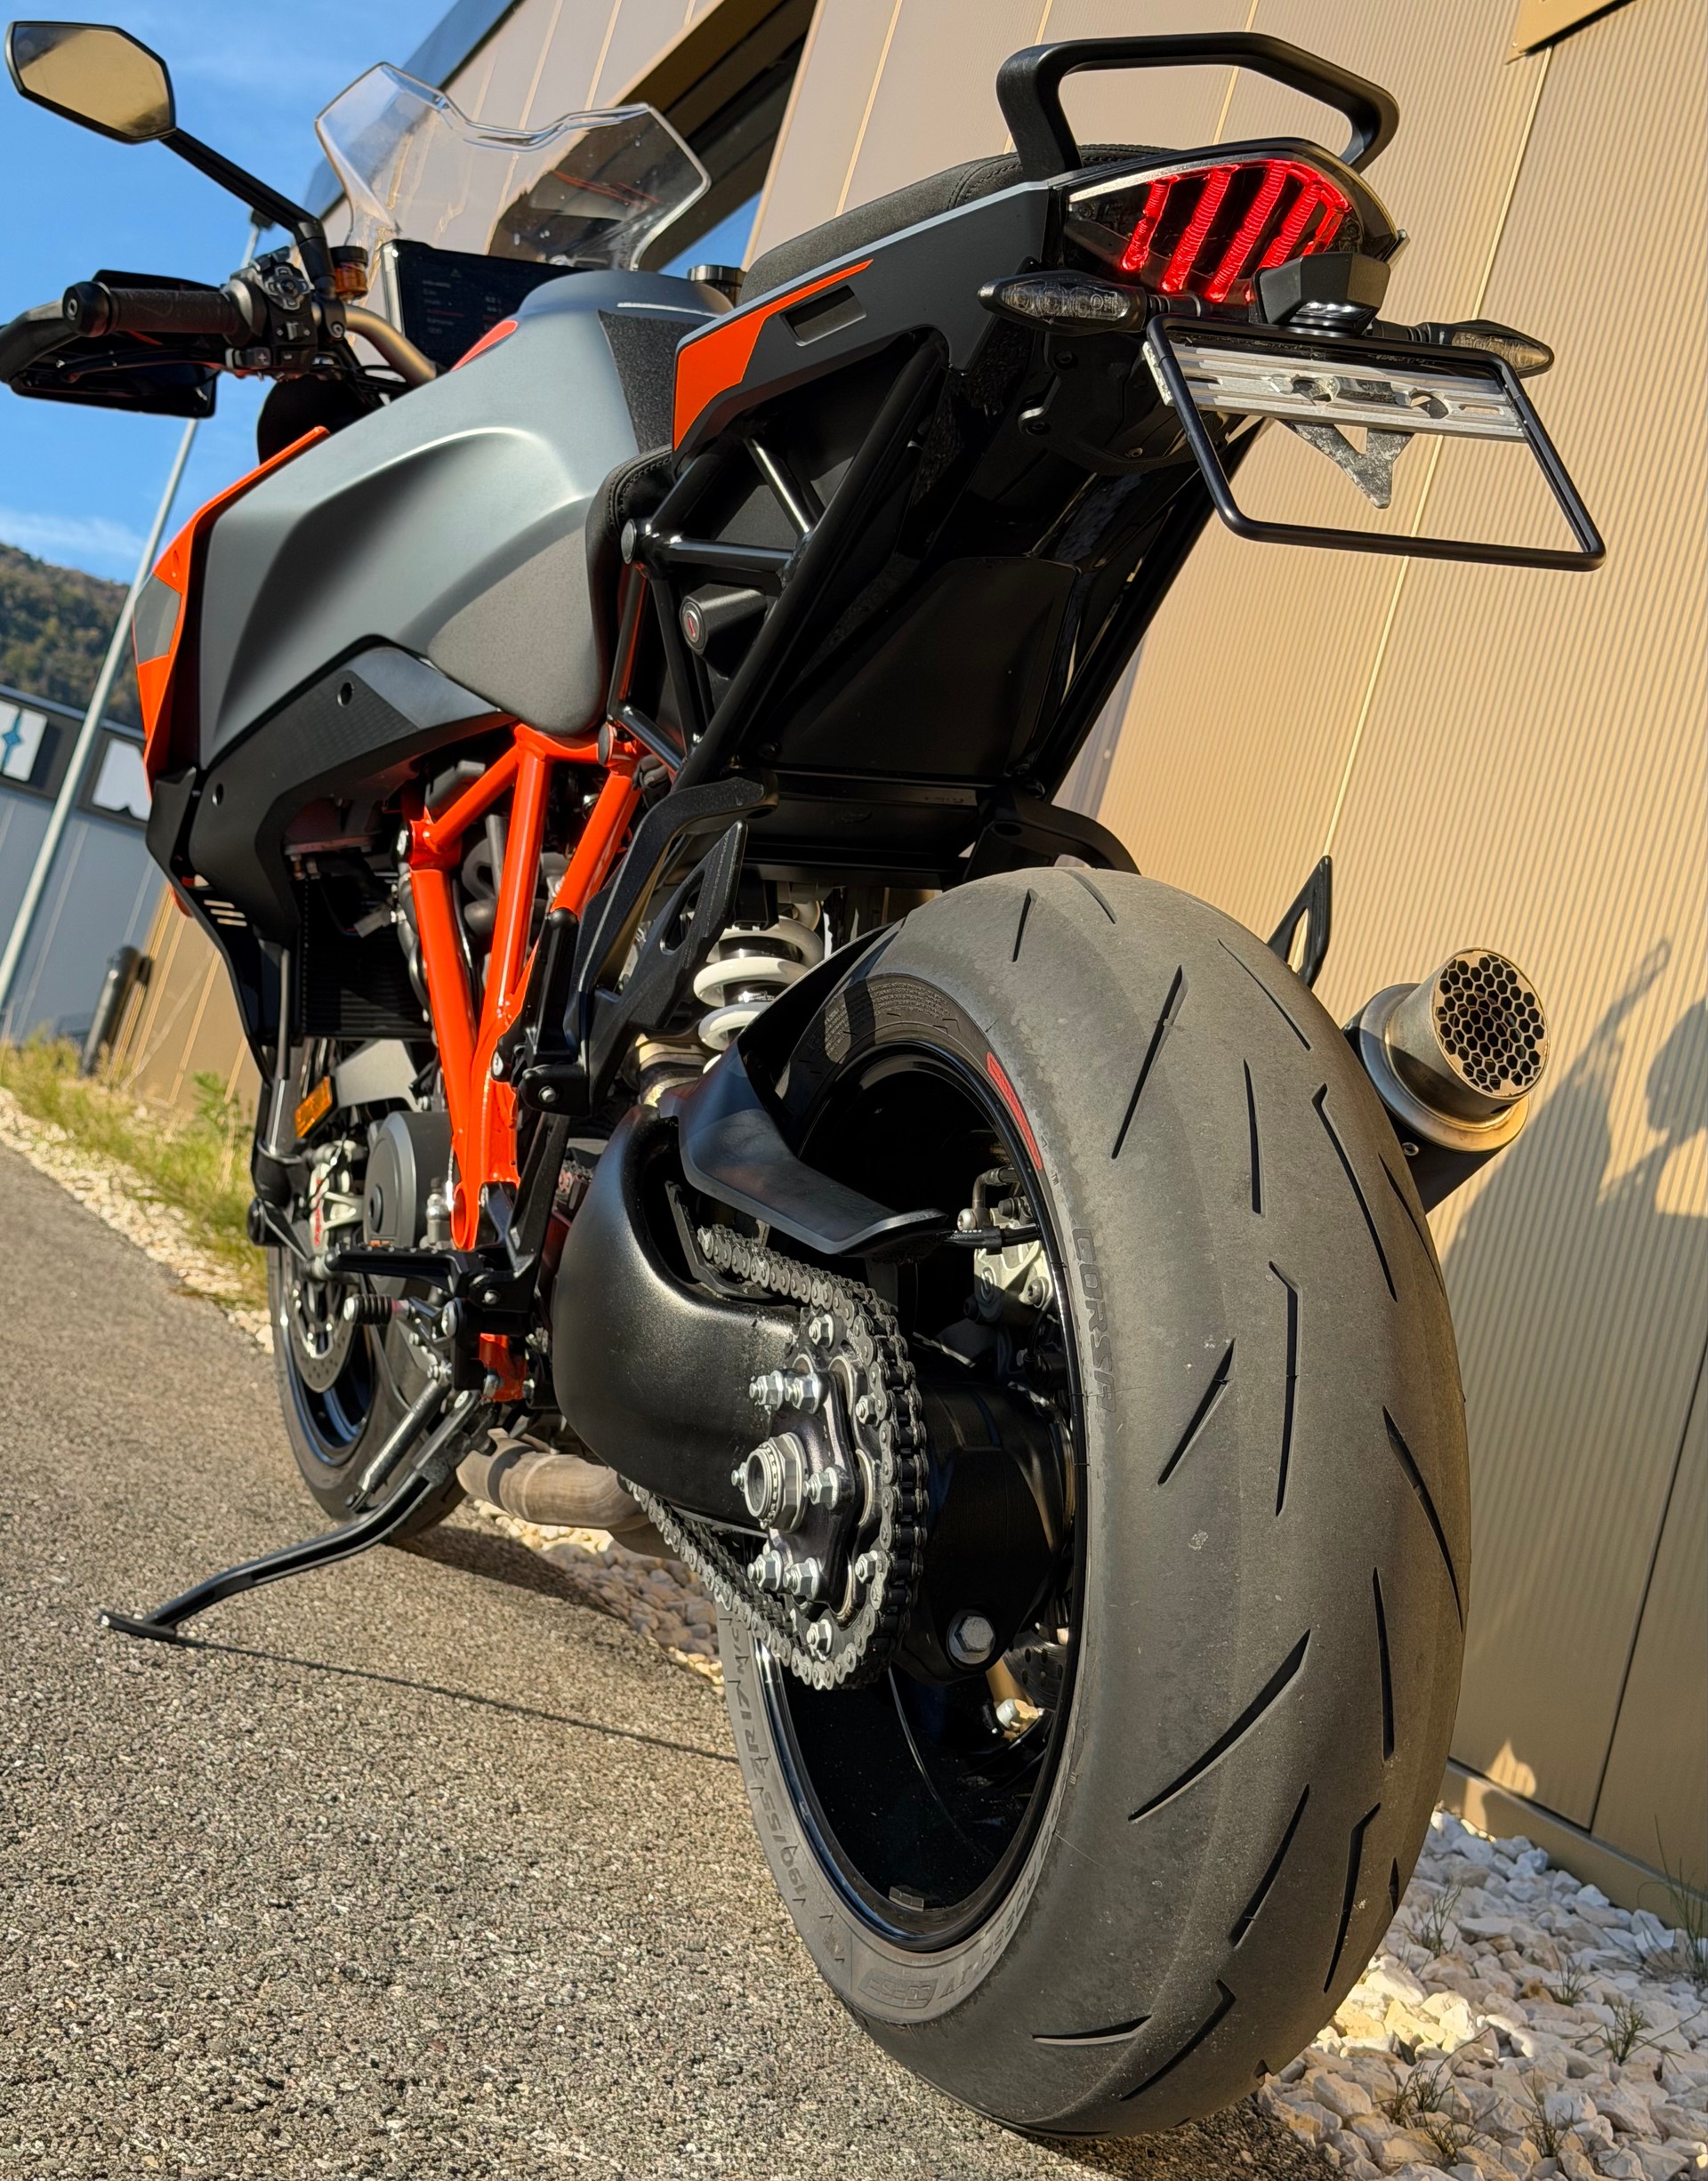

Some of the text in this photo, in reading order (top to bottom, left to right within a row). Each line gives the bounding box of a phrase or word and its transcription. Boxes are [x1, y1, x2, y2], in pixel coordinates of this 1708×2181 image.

[1071, 1227, 1116, 1412] CORSA
[737, 1687, 767, 1779] ZR17
[761, 1791, 807, 1895] 190/55
[980, 1861, 1037, 1970] ROSSO
